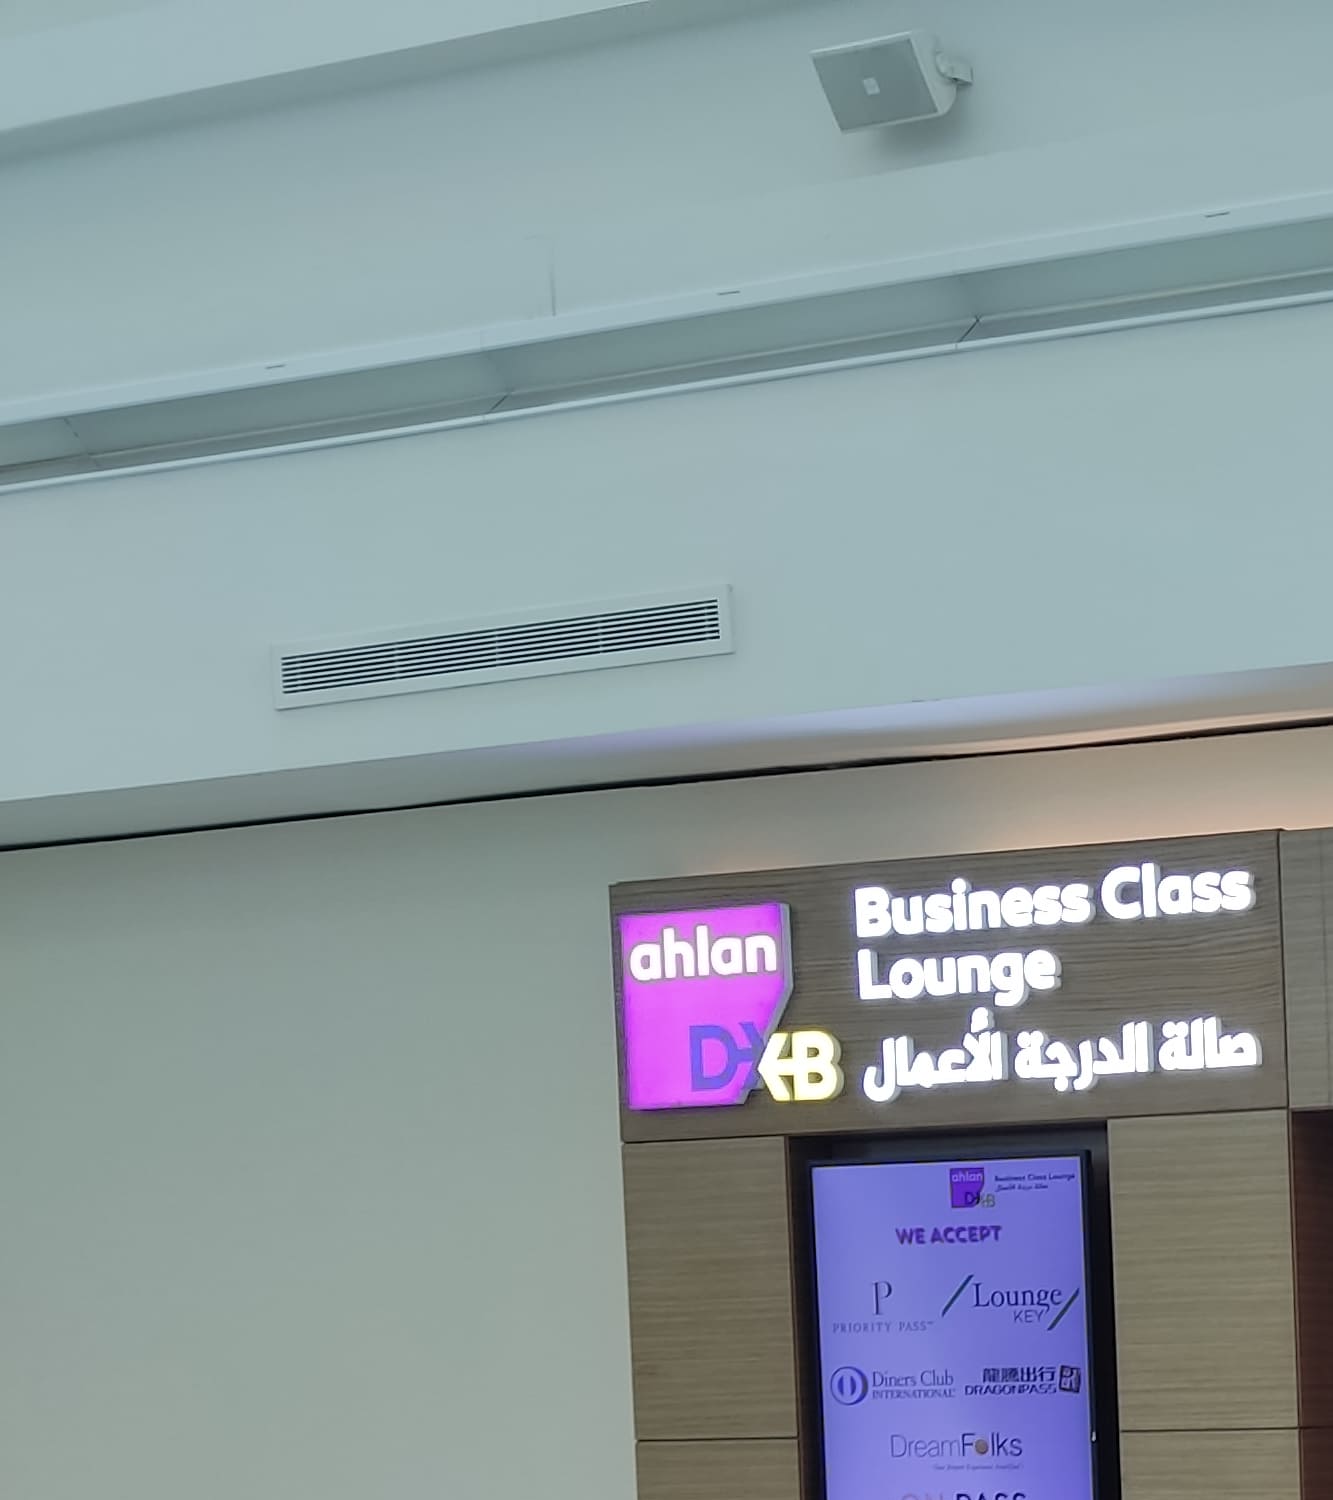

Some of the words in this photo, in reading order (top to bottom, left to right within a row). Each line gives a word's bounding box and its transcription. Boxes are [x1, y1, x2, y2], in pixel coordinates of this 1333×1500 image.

[853, 878, 1097, 939] Business
[1100, 862, 1256, 920] Class
[629, 925, 778, 982] ahlan
[857, 943, 1062, 1008] Lounge
[689, 1020, 845, 1103] DXB
[861, 1006, 1009, 1103] الأعمال
[1013, 1020, 1154, 1092] الدرجة
[1158, 1017, 1263, 1073] صالة
[952, 1170, 983, 1183] ahlan
[896, 1227, 926, 1245] WE
[930, 1225, 1002, 1244] ACCEPT
[972, 1282, 1063, 1313] Lounge
[1013, 1310, 1045, 1324] KEY
[832, 1322, 892, 1334] PRIORITY
[872, 1370, 917, 1388] Diners
[920, 1368, 954, 1386] Club
[964, 1383, 1057, 1396] DRAGONPASS
